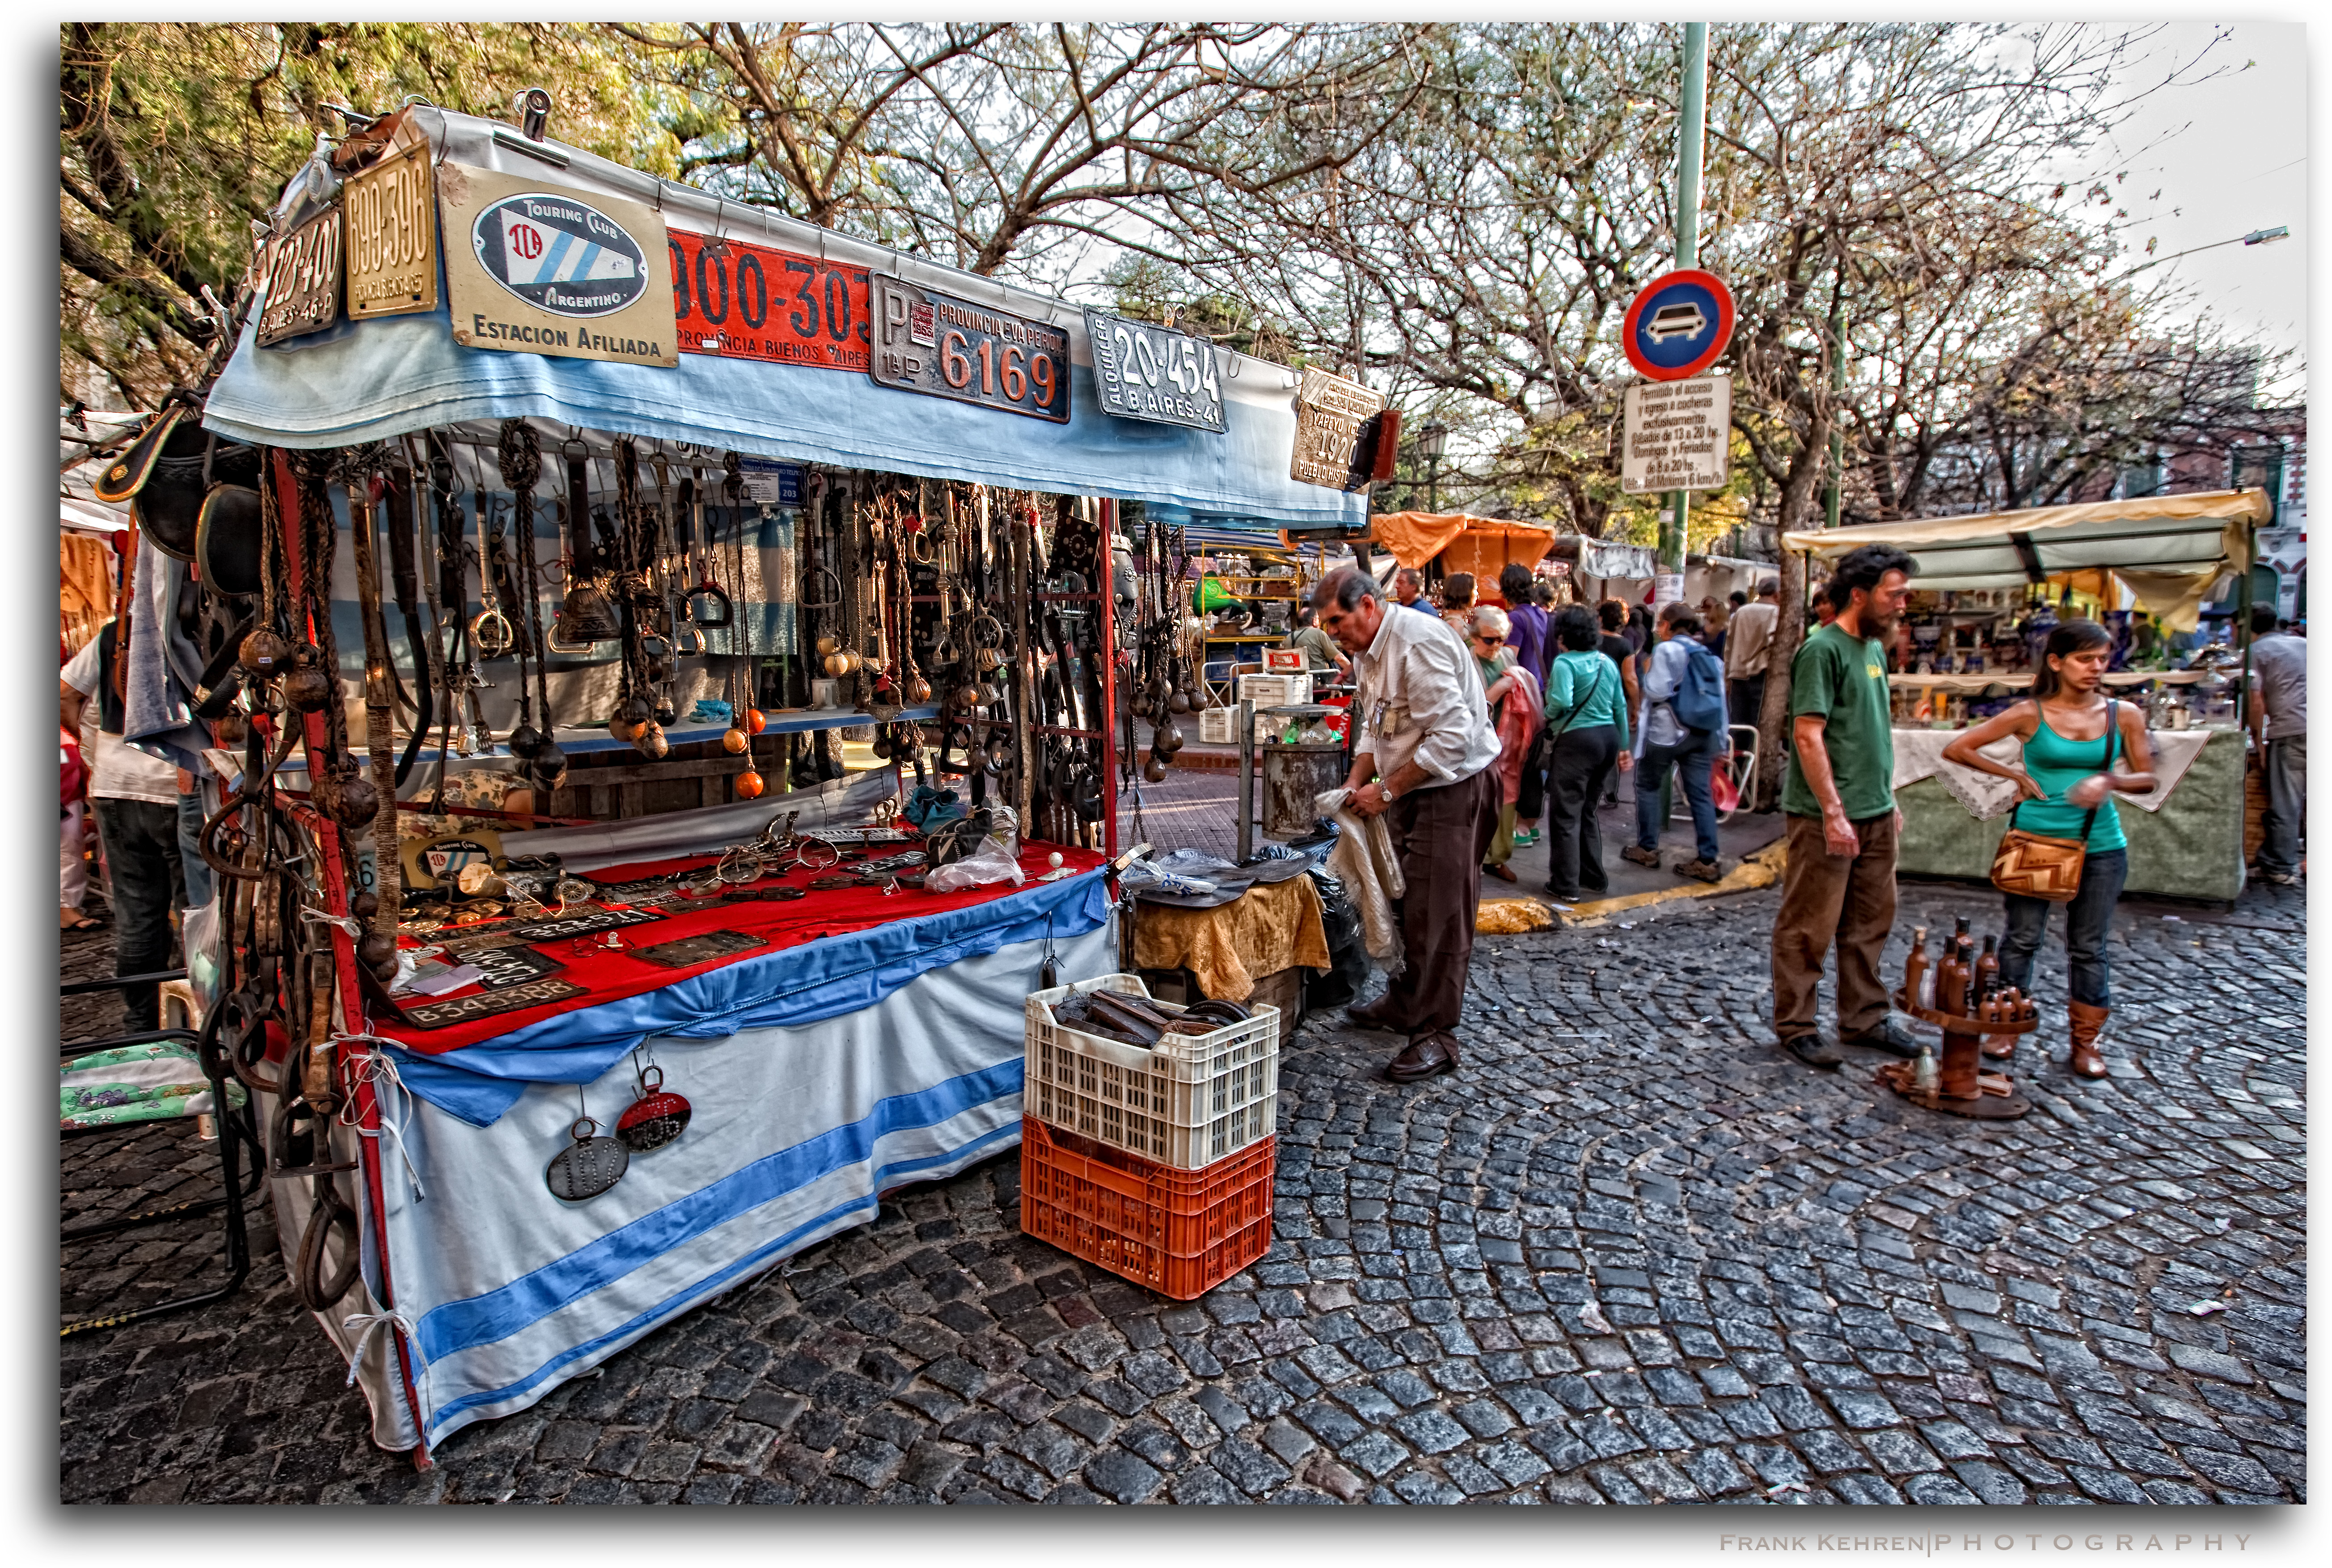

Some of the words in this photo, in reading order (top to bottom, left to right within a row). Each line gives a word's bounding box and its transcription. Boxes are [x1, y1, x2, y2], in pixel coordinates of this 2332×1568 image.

[347, 160, 427, 276] 699-396
[523, 199, 583, 223] TOURING
[586, 211, 618, 240] CLUB
[545, 287, 622, 308] ARGENTINO
[883, 287, 907, 344] P
[940, 302, 1001, 336] PROVINCIA
[1003, 322, 1025, 344] EVA
[473, 313, 569, 347] ESTACION
[578, 327, 662, 358] AFILIADA
[765, 340, 819, 360] BUENOS
[834, 349, 870, 366] AIRES
[903, 356, 921, 377] P
[941, 329, 1056, 407] 6169
[1114, 326, 1219, 403] 20-454
[1639, 384, 1673, 400] Permitido
[1675, 383, 1683, 395] el
[1684, 383, 1713, 394] acceso
[1637, 405, 1643, 417] y
[1644, 402, 1668, 417] egreso
[1669, 401, 1675, 410] a
[1677, 396, 1713, 410] cocheras
[1313, 412, 1345, 432] YAPEYU
[1642, 413, 1706, 430] exclusivamente
[1662, 429, 1672, 441] de
[1674, 427, 1684, 440] 13
[1686, 430, 1691, 439] a
[1693, 426, 1705, 439] 20
[1633, 445, 1668, 459] Domingos
[1672, 446, 1677, 457] y
[1678, 441, 1713, 454] Feriados
[1299, 459, 1327, 479] PUEBLO
[1647, 462, 1655, 474] de
[1656, 460, 1663, 473] 8
[1672, 459, 1682, 471] 20
[1624, 476, 1655, 490] Velodad
[1688, 472, 1695, 485] 6
[783, 489, 796, 497] 203
[435, 843, 460, 851] TOURING
[461, 841, 477, 849] CLUB
